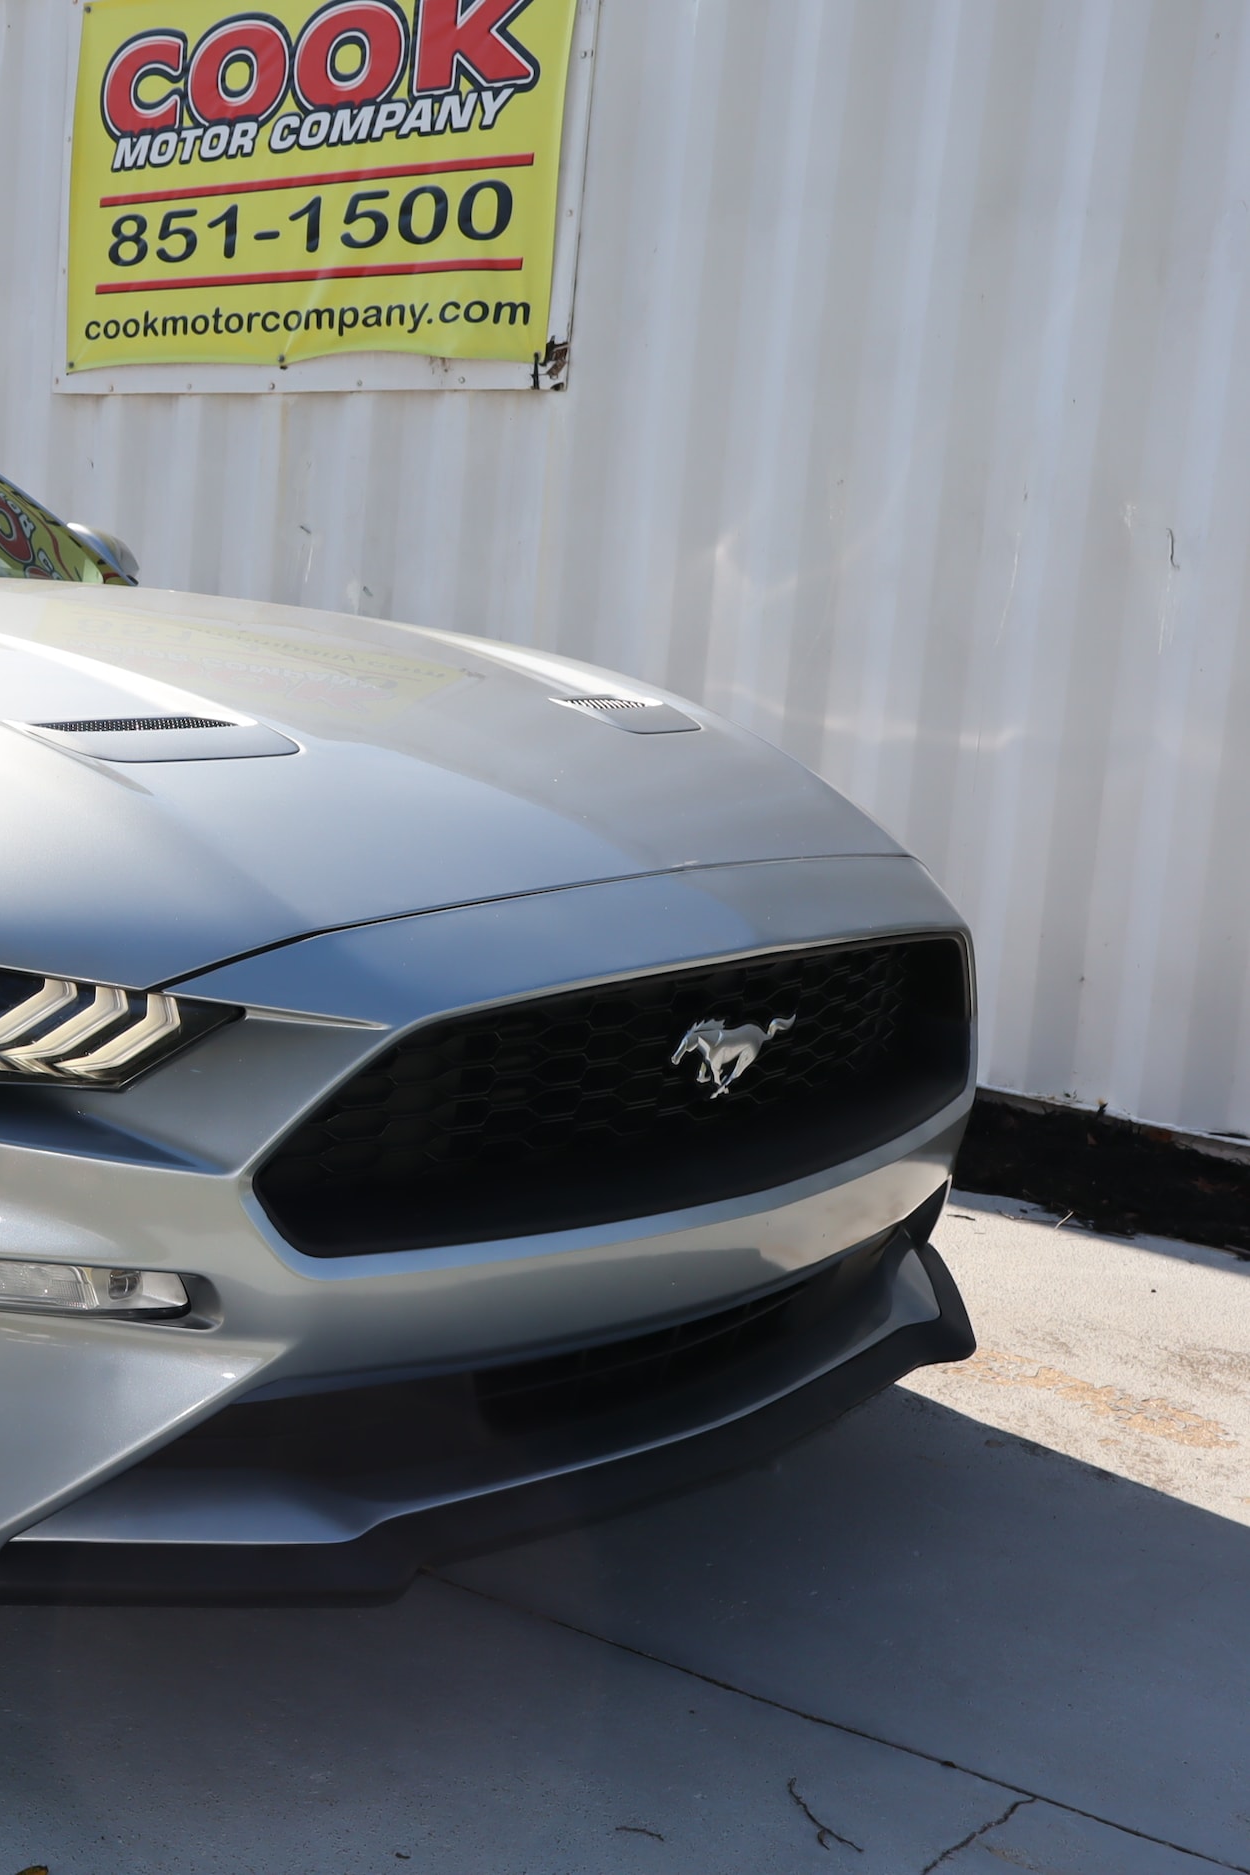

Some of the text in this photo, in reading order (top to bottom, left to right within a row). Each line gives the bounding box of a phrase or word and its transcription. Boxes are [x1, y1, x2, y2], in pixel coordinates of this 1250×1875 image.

[101, 0, 540, 142] COOK
[111, 84, 516, 172] MOTOR COMPANY
[108, 179, 513, 267] 851-1500
[85, 300, 531, 340] cookmotorcompany.com
